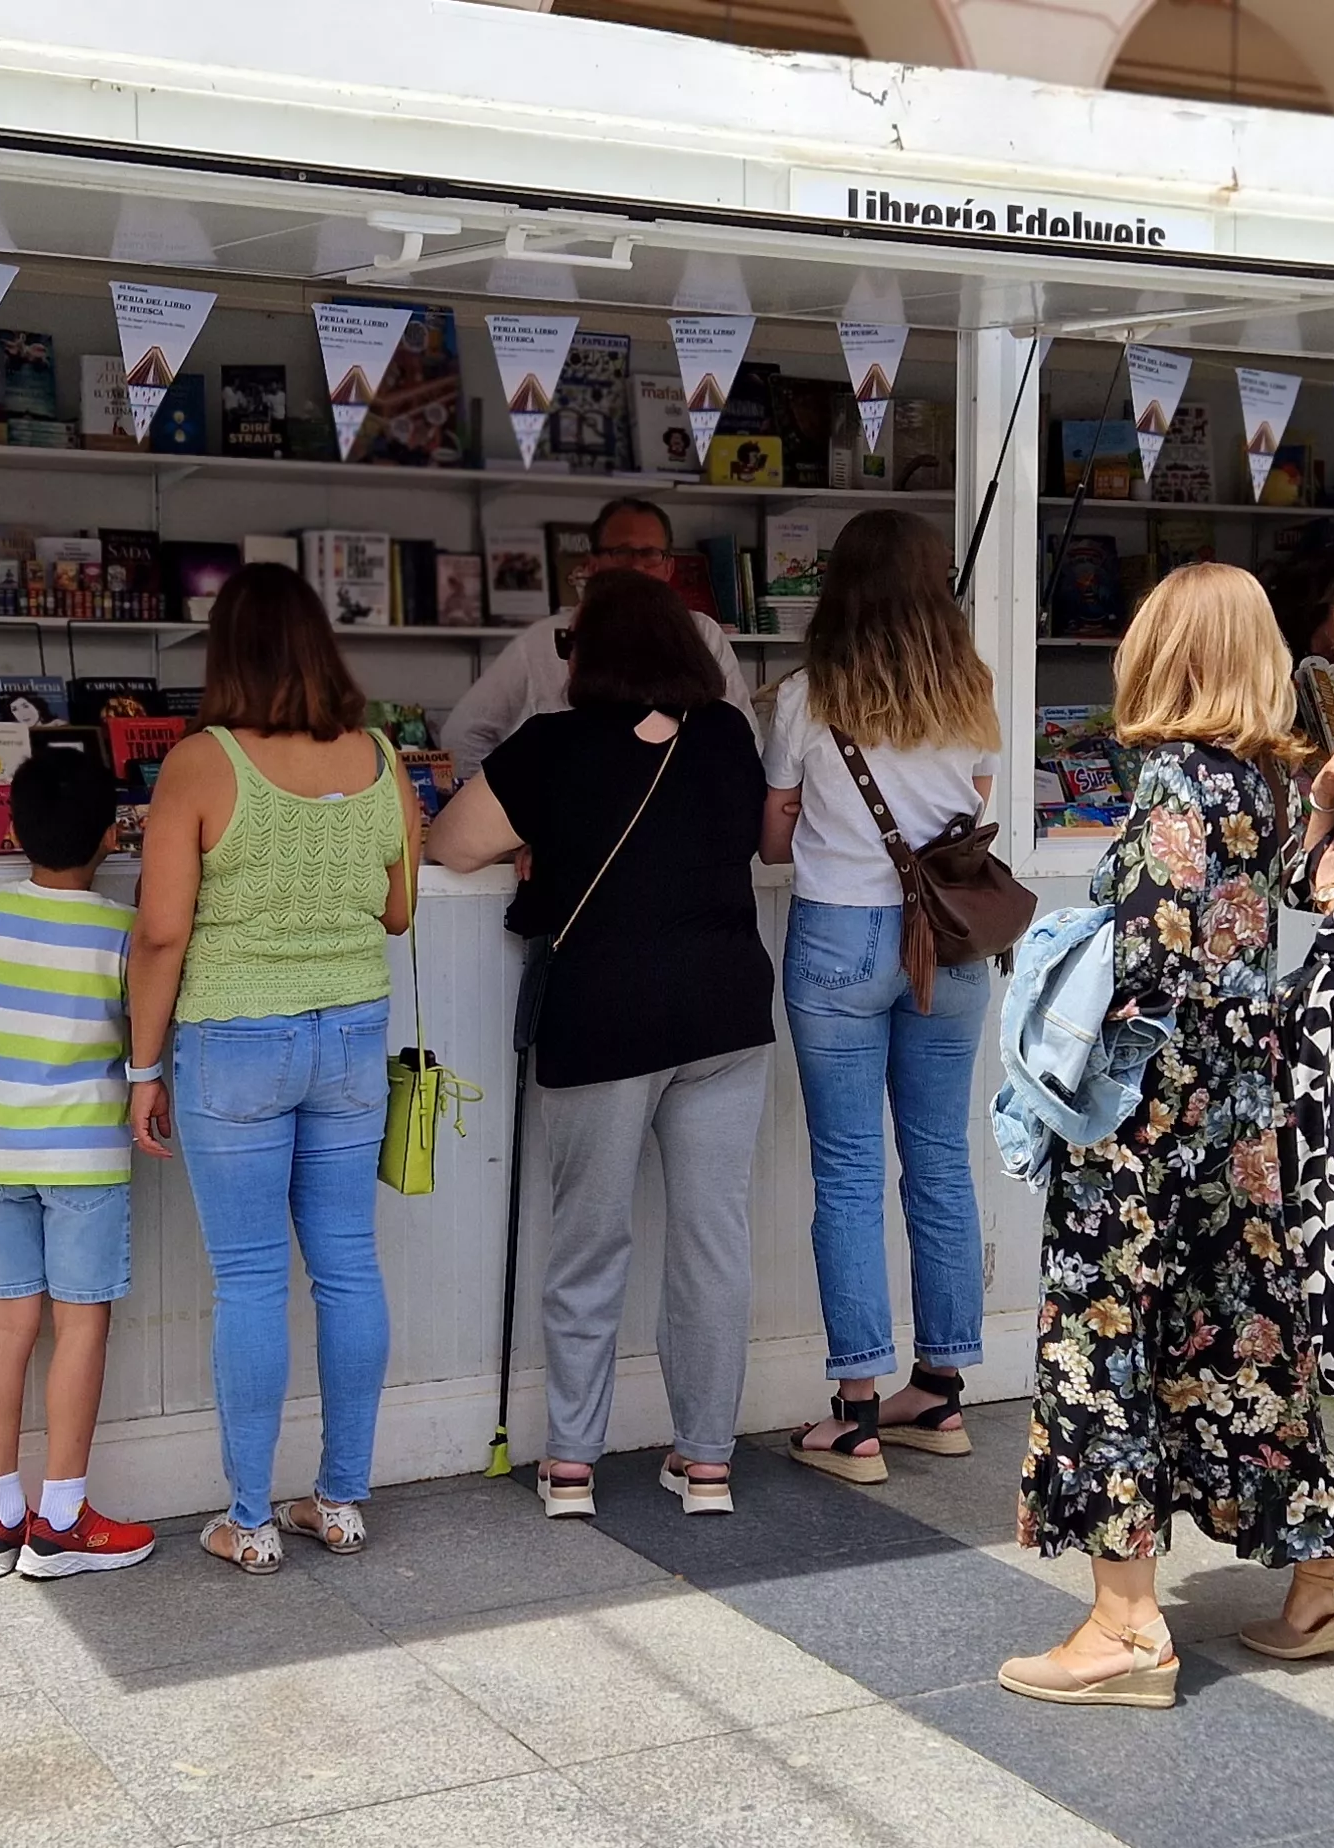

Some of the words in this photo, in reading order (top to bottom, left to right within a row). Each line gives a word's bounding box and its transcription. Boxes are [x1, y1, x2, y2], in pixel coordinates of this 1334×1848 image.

[118, 294, 144, 304] FERIA
[147, 297, 162, 305] DEL
[164, 301, 191, 310] LIBRO
[129, 305, 164, 316] HUESCA
[320, 315, 344, 323] FERIA
[346, 318, 362, 326] DEL
[331, 326, 363, 335] HUESCA
[642, 386, 688, 401] mafal
[240, 422, 271, 433] DIRE
[228, 431, 283, 444] STRAITS
[108, 543, 151, 560] SADA
[86, 681, 125, 691] CARMEN
[127, 682, 153, 691] MOLA
